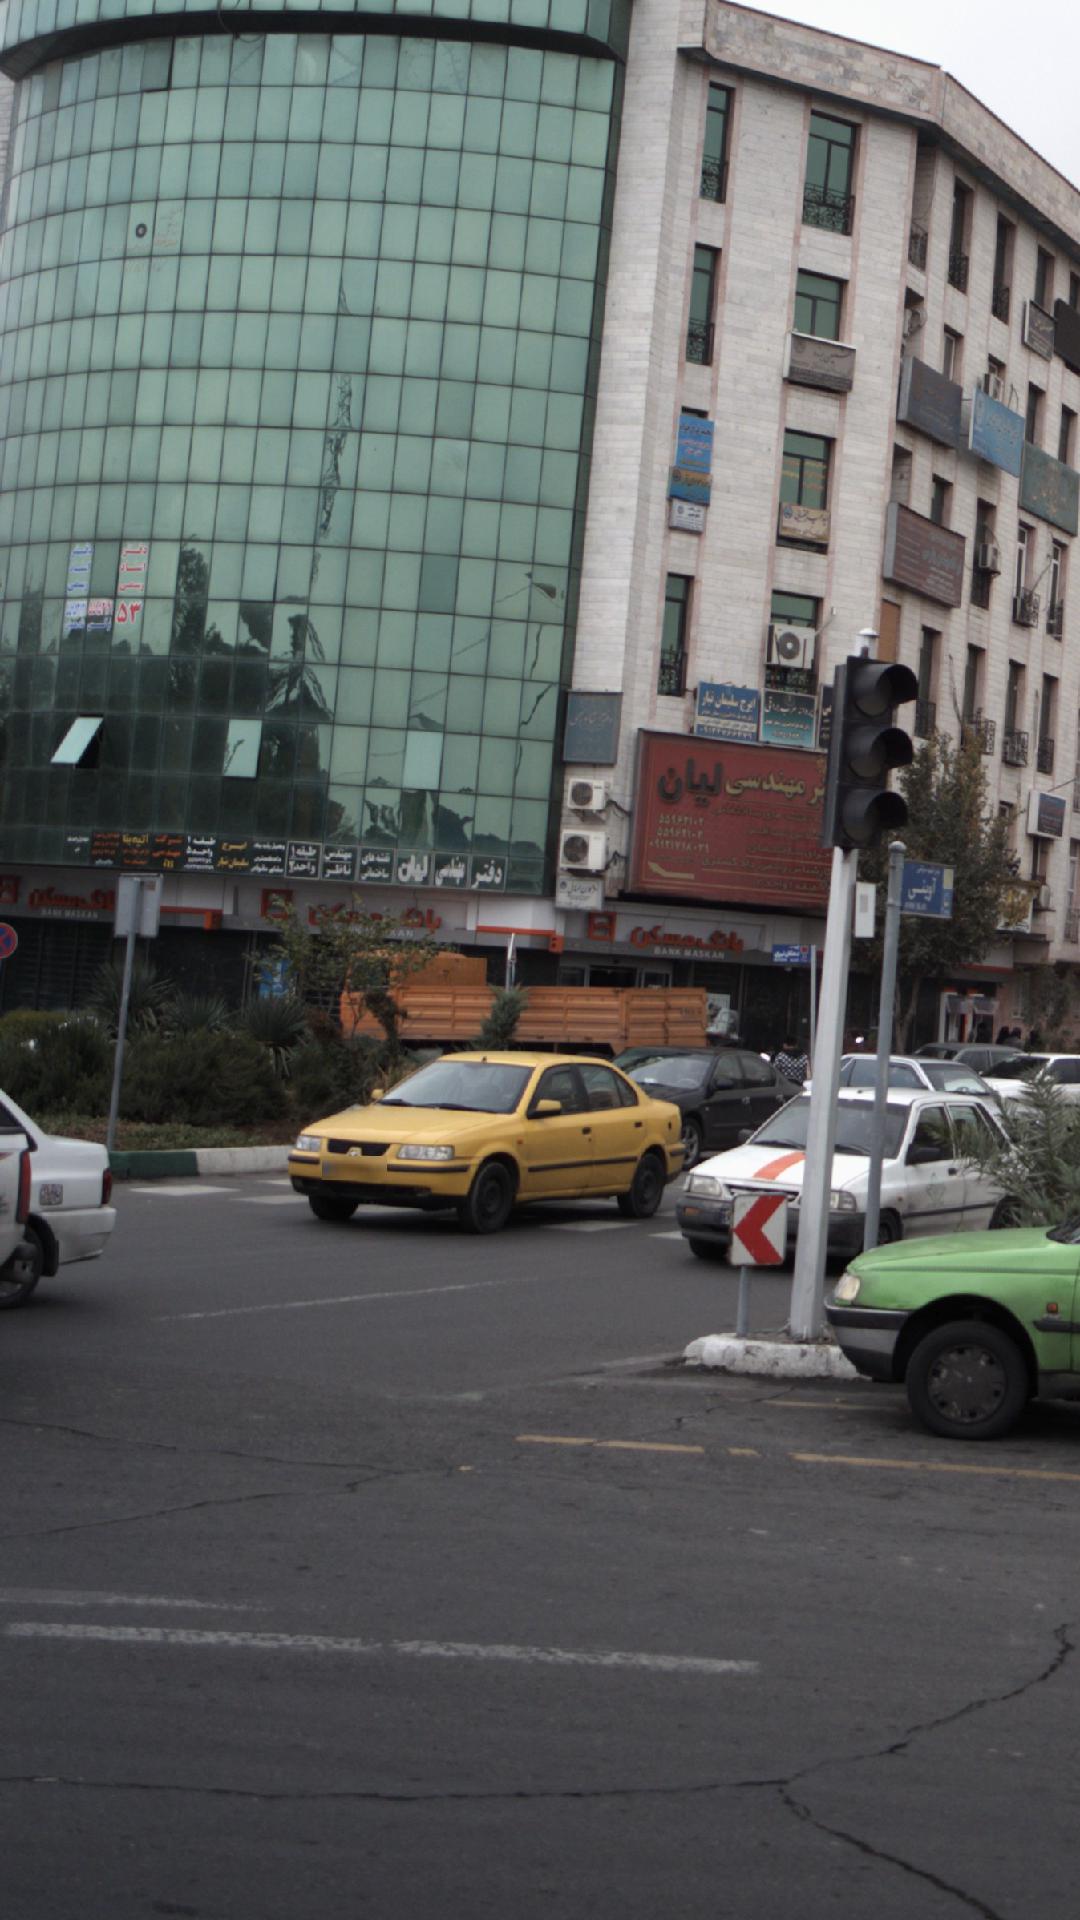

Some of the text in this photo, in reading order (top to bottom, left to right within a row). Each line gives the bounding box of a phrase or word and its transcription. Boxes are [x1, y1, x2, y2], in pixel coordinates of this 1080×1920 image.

[116, 602, 141, 623] ۵۳
[657, 757, 723, 807] لیان
[725, 772, 805, 799] مهندسی
[398, 855, 428, 882] لیان
[471, 860, 502, 889] دفتر
[653, 946, 725, 959] BANK MASKAN
